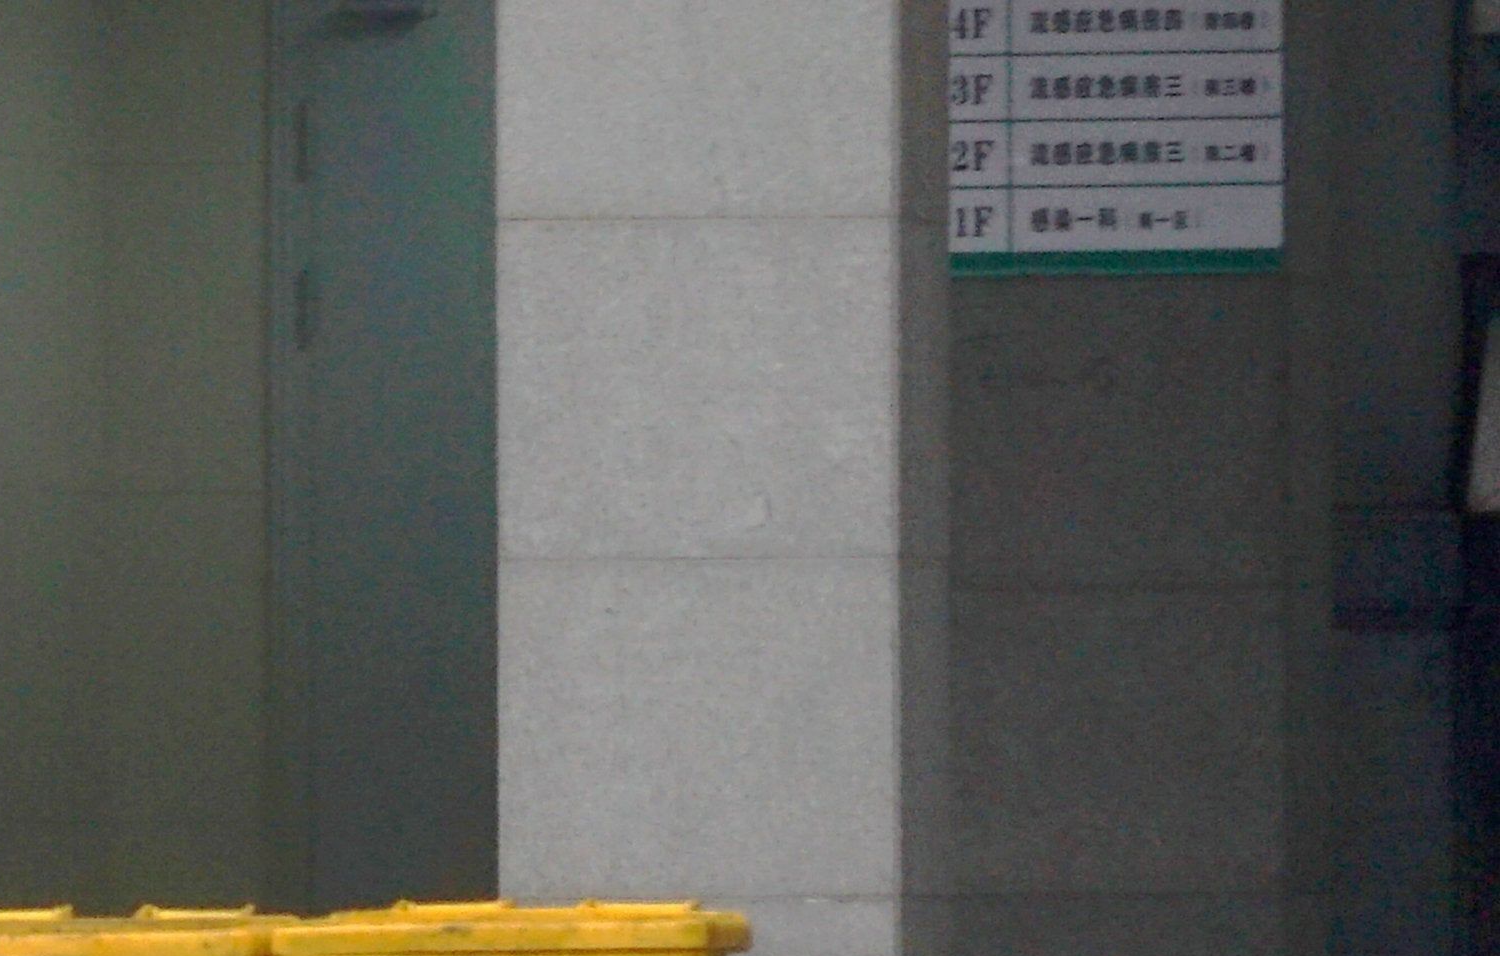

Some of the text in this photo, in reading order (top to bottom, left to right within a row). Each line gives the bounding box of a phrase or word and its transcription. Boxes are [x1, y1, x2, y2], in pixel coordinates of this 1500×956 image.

[953, 9, 990, 39] 4F
[952, 74, 993, 105] 3F
[952, 140, 994, 171] 2F
[955, 206, 993, 237] 1F
